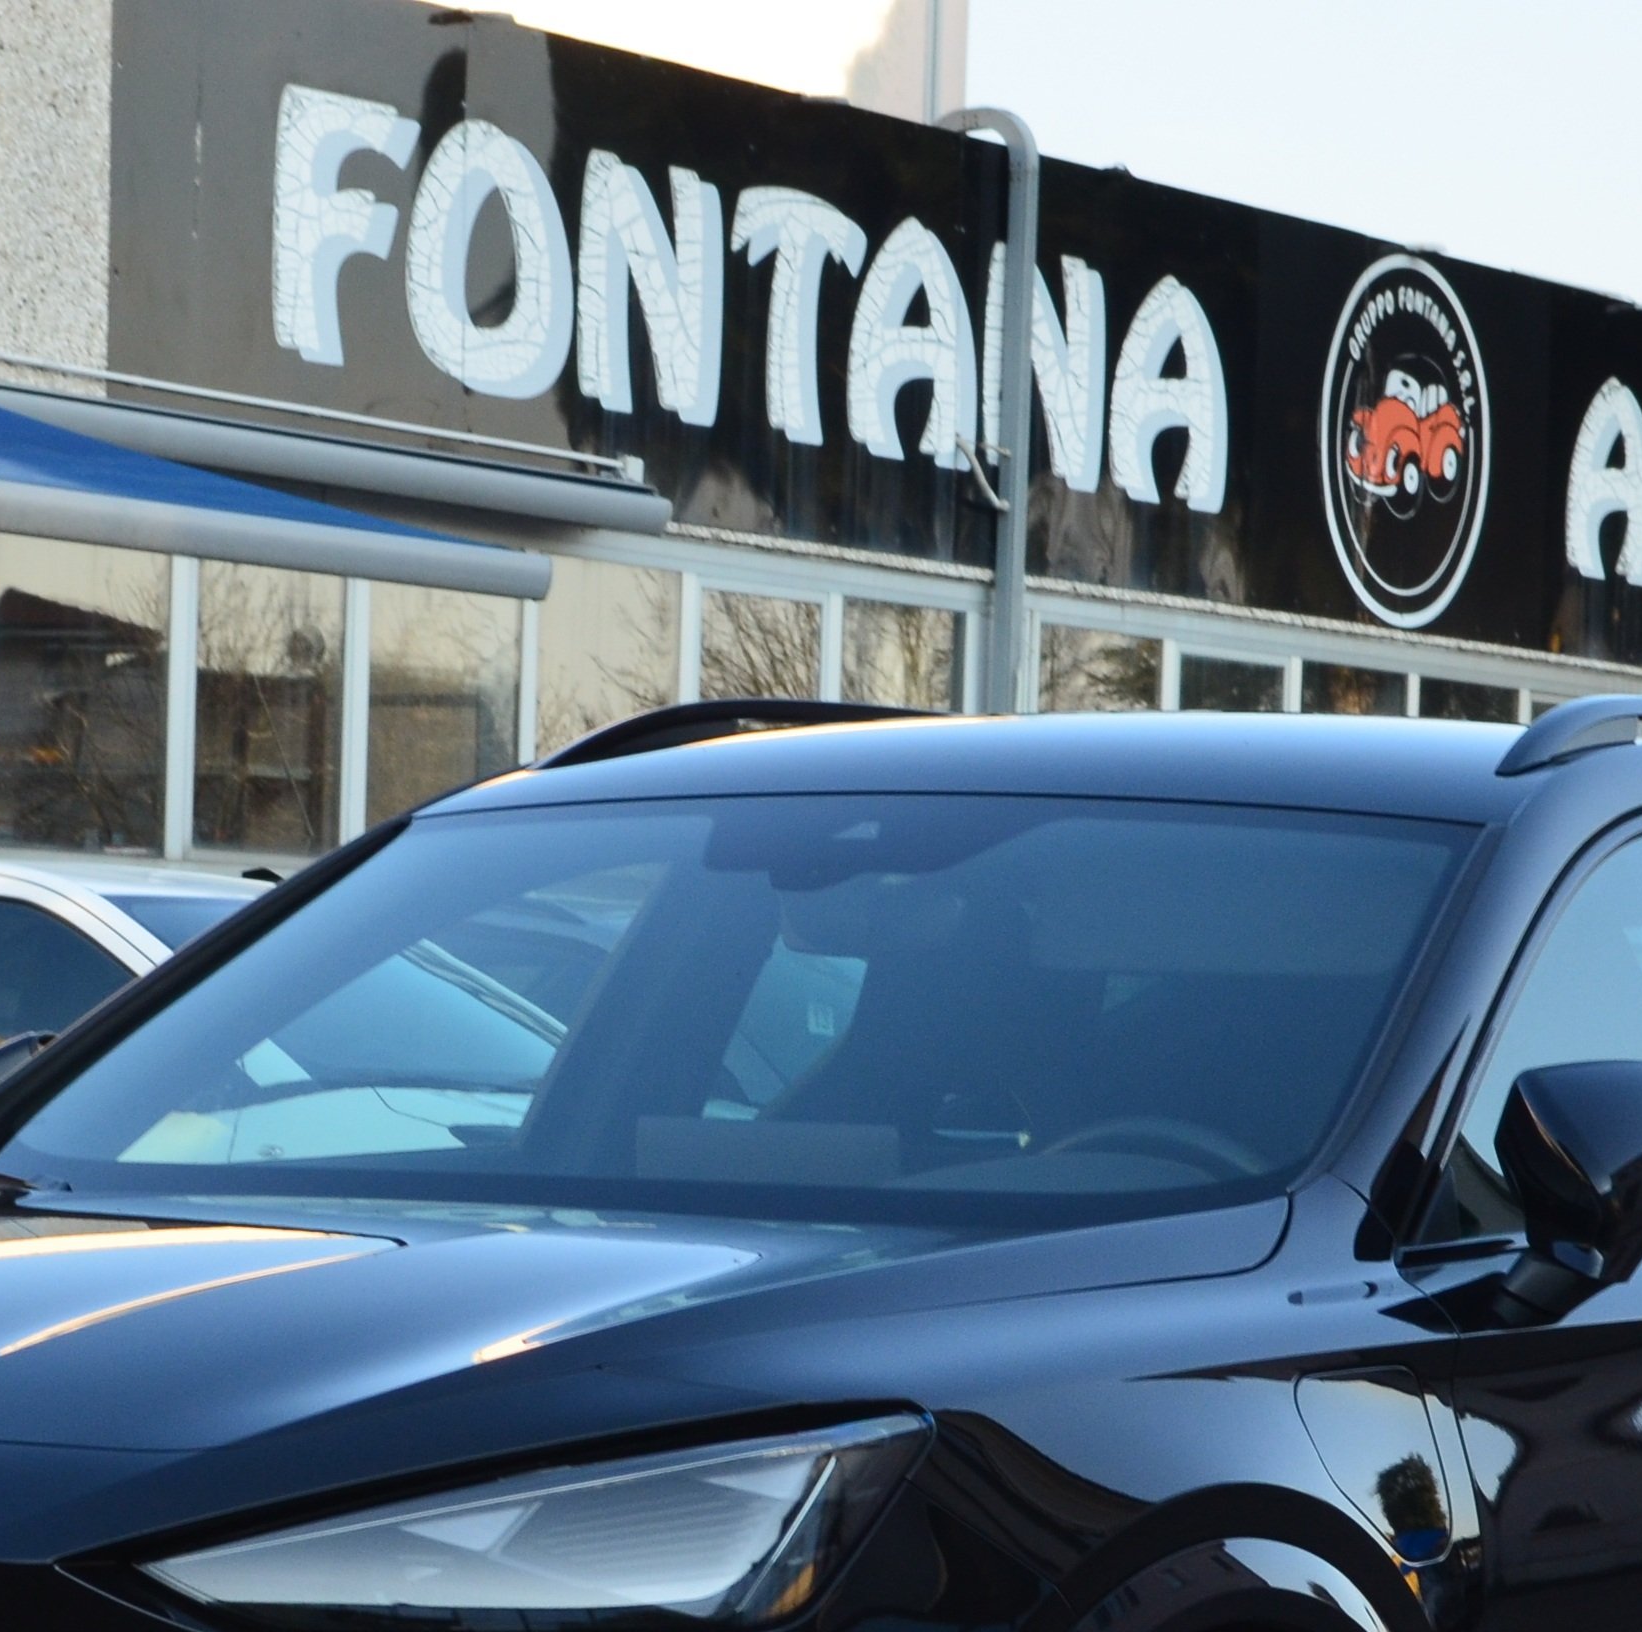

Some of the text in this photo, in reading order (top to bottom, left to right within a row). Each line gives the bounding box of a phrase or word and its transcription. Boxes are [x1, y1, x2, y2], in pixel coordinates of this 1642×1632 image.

[272, 82, 1227, 514] FONTANA
[1349, 289, 1395, 361] GRUPPO
[1398, 285, 1456, 352] FONTANA
